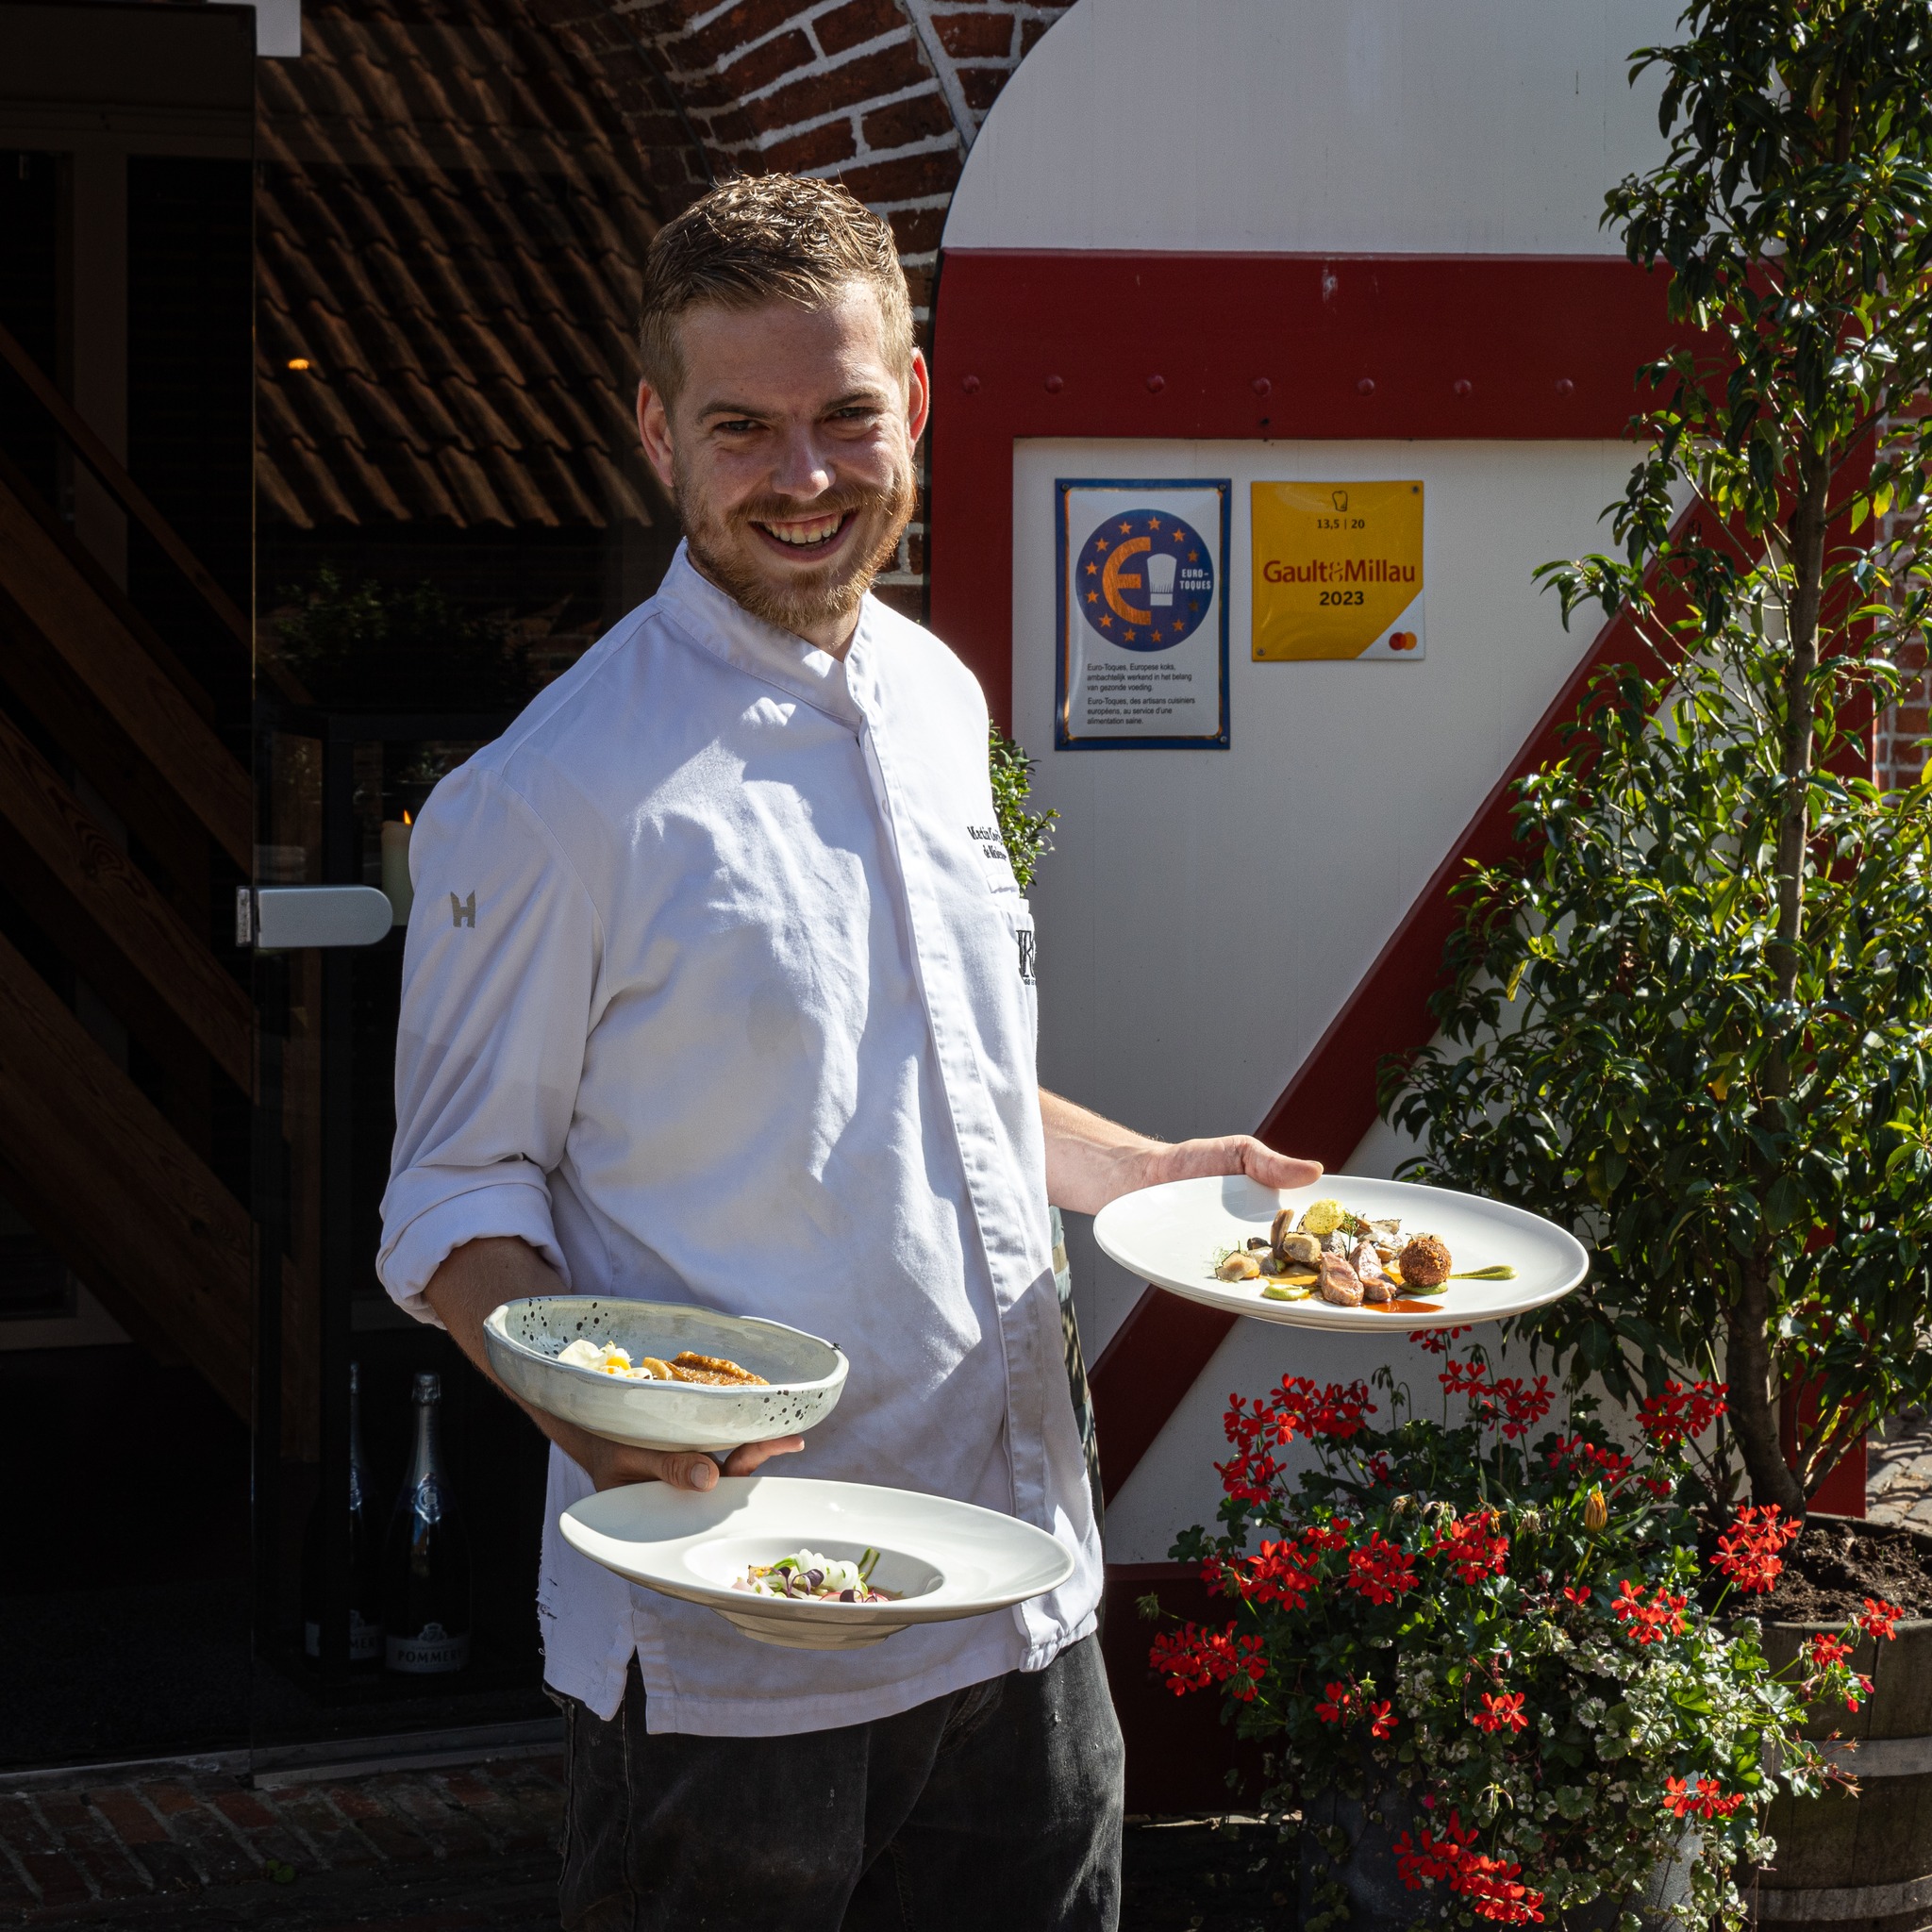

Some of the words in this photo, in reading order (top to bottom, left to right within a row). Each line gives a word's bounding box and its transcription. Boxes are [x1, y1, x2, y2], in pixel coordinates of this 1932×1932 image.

[1317, 518, 1341, 530] 13,5
[1350, 518, 1366, 529] 20
[1181, 567, 1209, 578] EURO-
[1262, 558, 1417, 584] Gault&Millau
[1179, 579, 1211, 591] TOQUES
[1318, 590, 1365, 607] 2023
[1088, 663, 1128, 673] Euro-Toques,
[1129, 663, 1158, 672] Europese
[1159, 662, 1176, 671] koks,
[1088, 674, 1126, 682] ambachtelijk
[1154, 673, 1160, 681] in
[1161, 673, 1171, 681] het
[1172, 673, 1192, 682] belang
[1100, 684, 1126, 692] gezonde
[1127, 683, 1154, 692] voeding.
[1088, 697, 1128, 706] Euro-Toques,
[1167, 696, 1196, 705] cuisiniers
[1088, 708, 1122, 716] européens,
[1132, 707, 1155, 715] service
[1155, 707, 1173, 715] d'une
[1088, 717, 1124, 725] alimentation
[1124, 717, 1144, 725] saine.
